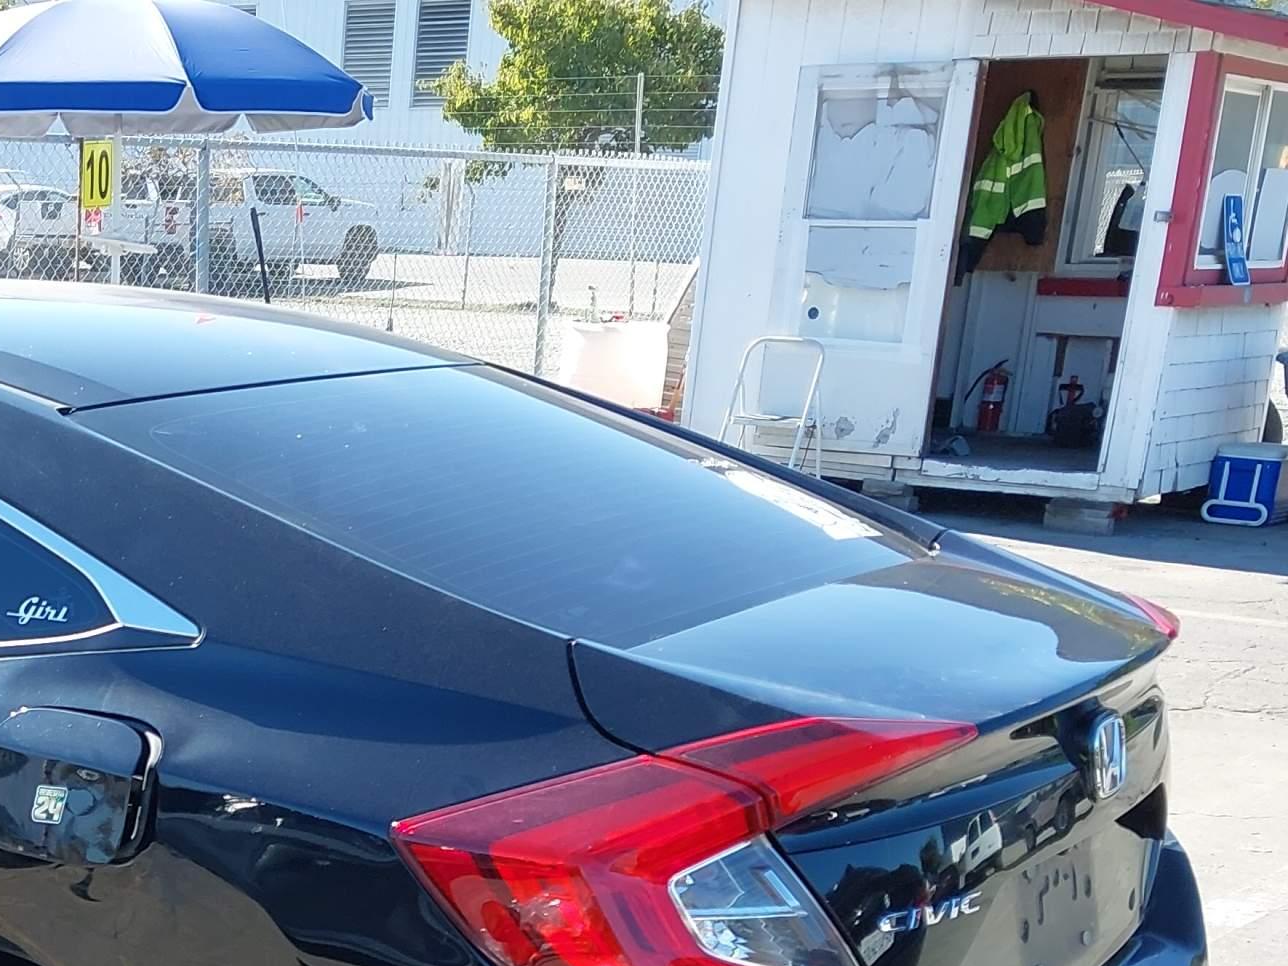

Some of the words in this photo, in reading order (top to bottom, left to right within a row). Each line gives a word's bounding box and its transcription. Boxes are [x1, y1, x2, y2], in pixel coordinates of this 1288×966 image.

[86, 149, 110, 200] 10
[6, 596, 68, 625] Girl
[34, 795, 63, 820] 24
[879, 891, 983, 932] CIVIC
